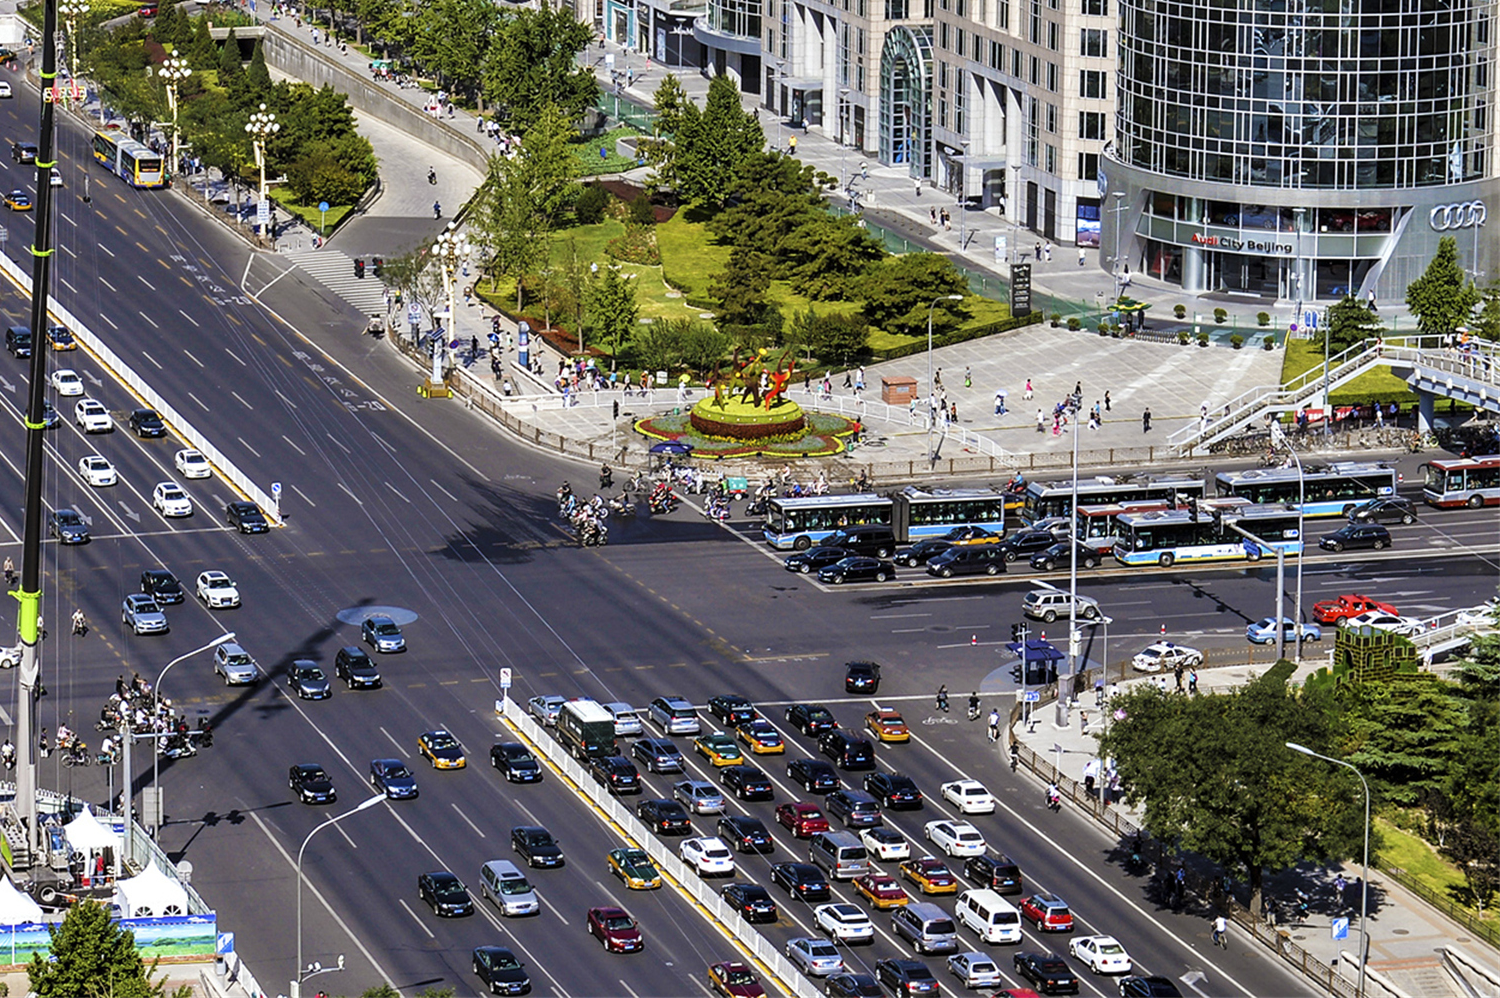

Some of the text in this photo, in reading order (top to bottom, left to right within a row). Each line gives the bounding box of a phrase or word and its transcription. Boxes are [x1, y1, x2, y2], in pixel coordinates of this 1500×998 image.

[1191, 232, 1293, 253] Audi City Beijing
